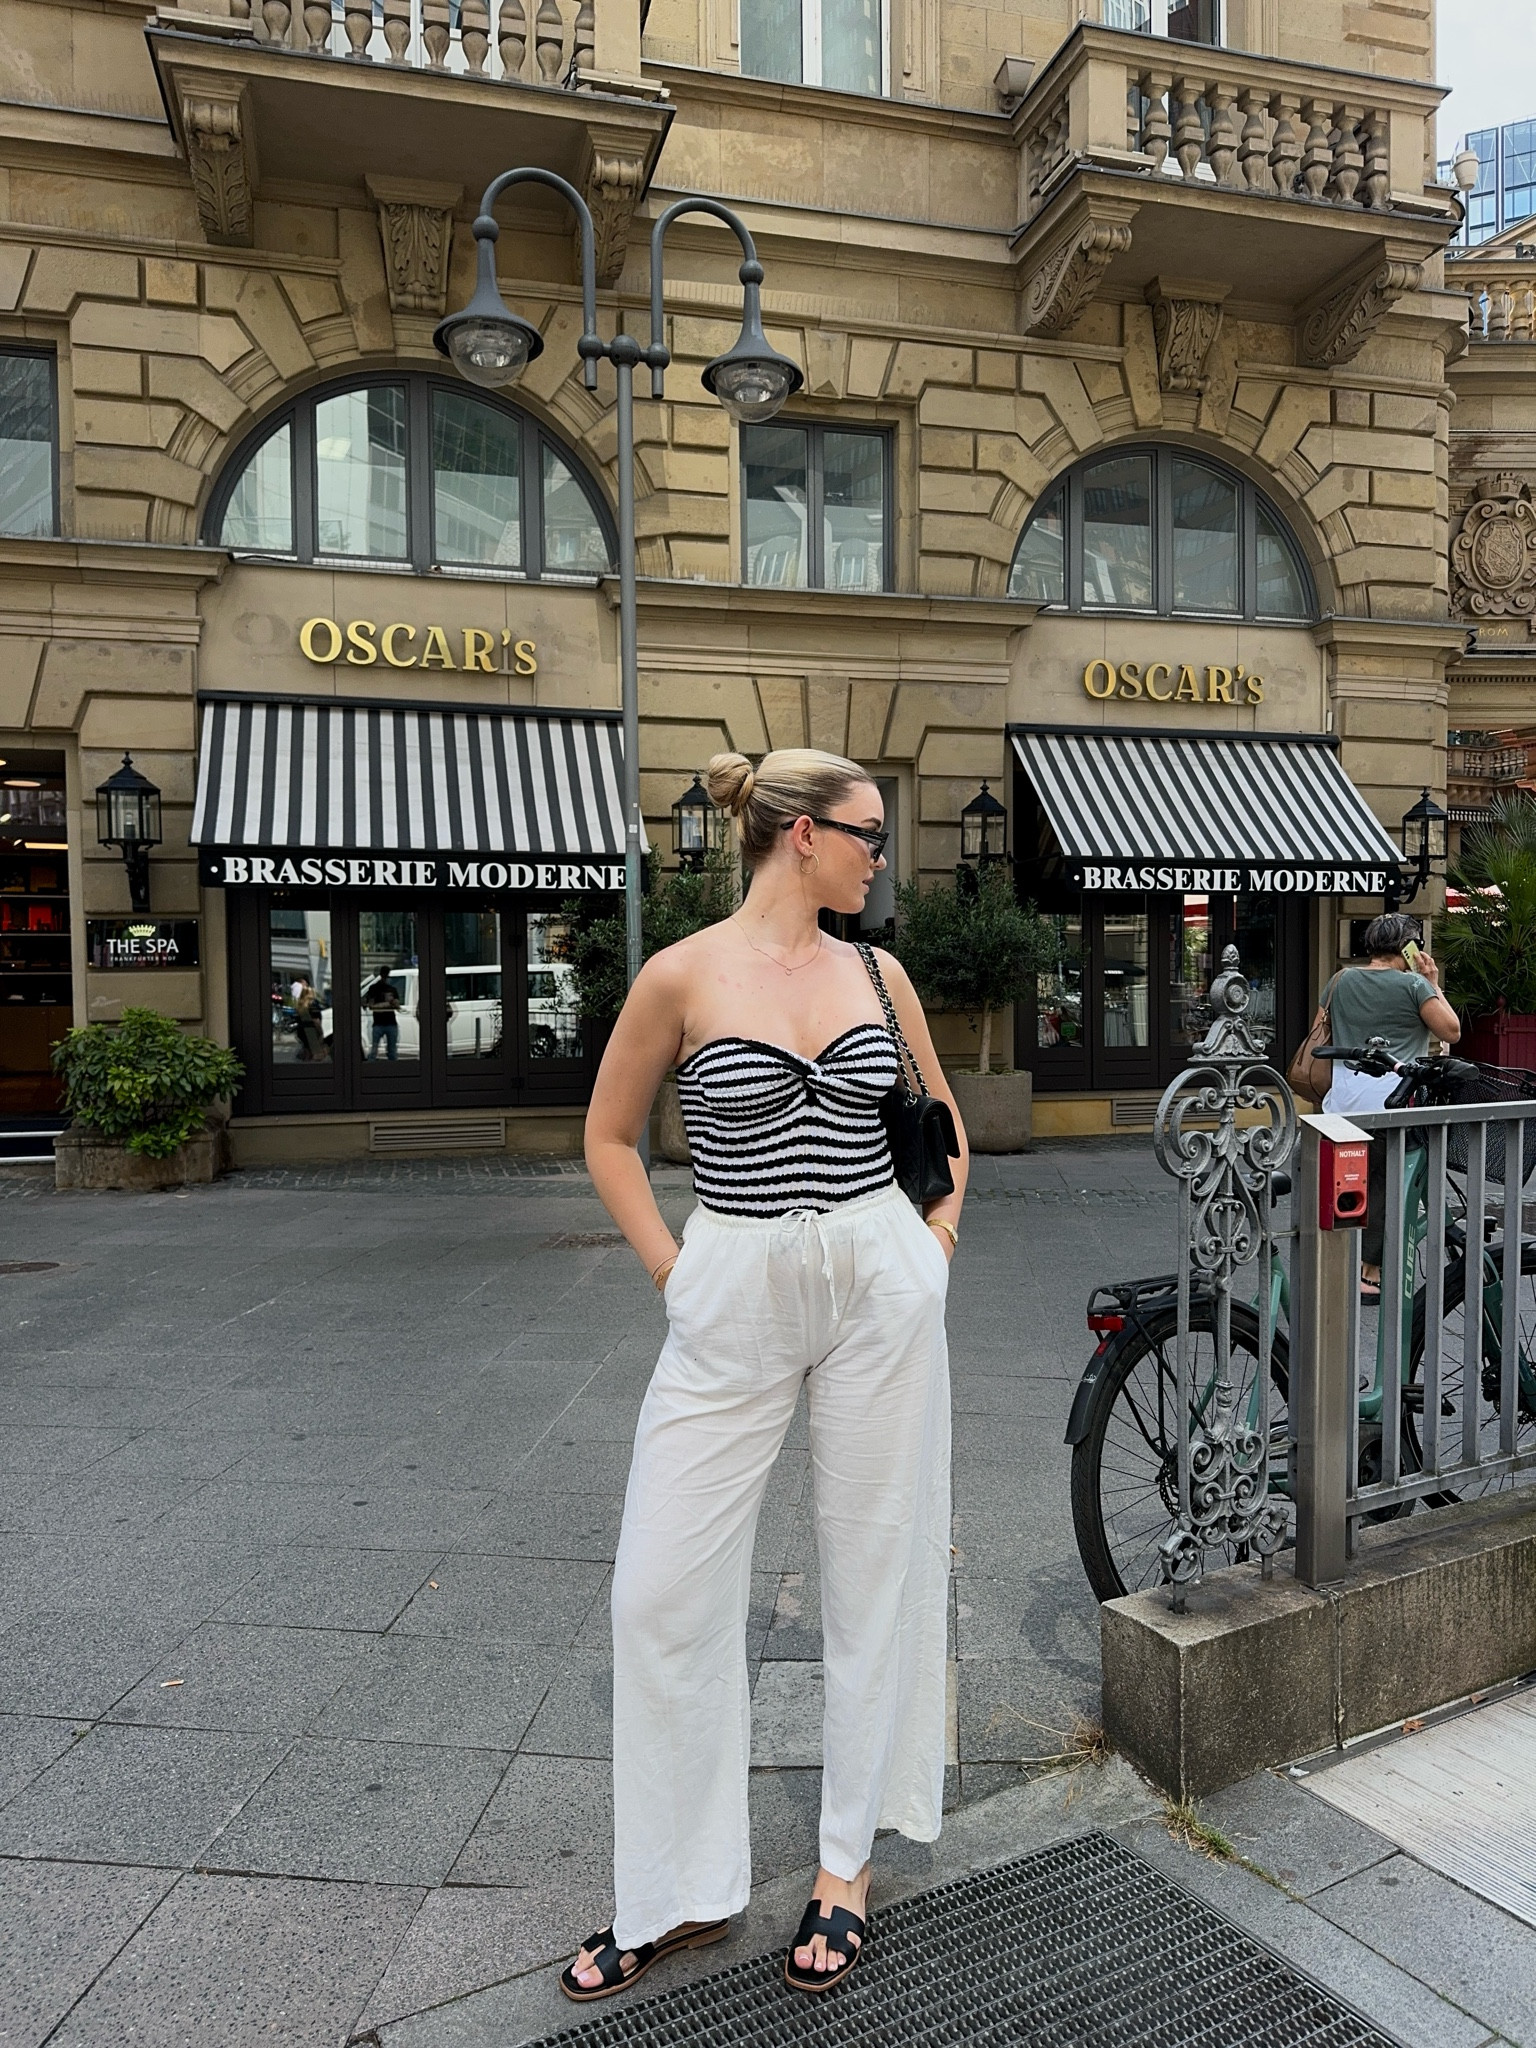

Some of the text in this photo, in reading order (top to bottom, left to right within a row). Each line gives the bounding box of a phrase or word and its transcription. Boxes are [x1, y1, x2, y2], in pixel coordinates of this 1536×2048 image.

[299, 617, 538, 675] OSCAR's
[1479, 628, 1509, 636] ROM
[1084, 659, 1265, 704] OSCAR's
[222, 856, 627, 890] BRASSERIE MODERNE
[1082, 866, 1387, 893] BRASSERIE MODERNE
[106, 938, 179, 954] THE SPA
[1339, 1149, 1366, 1158] NOTHALT
[1404, 1223, 1416, 1299] CUBE
